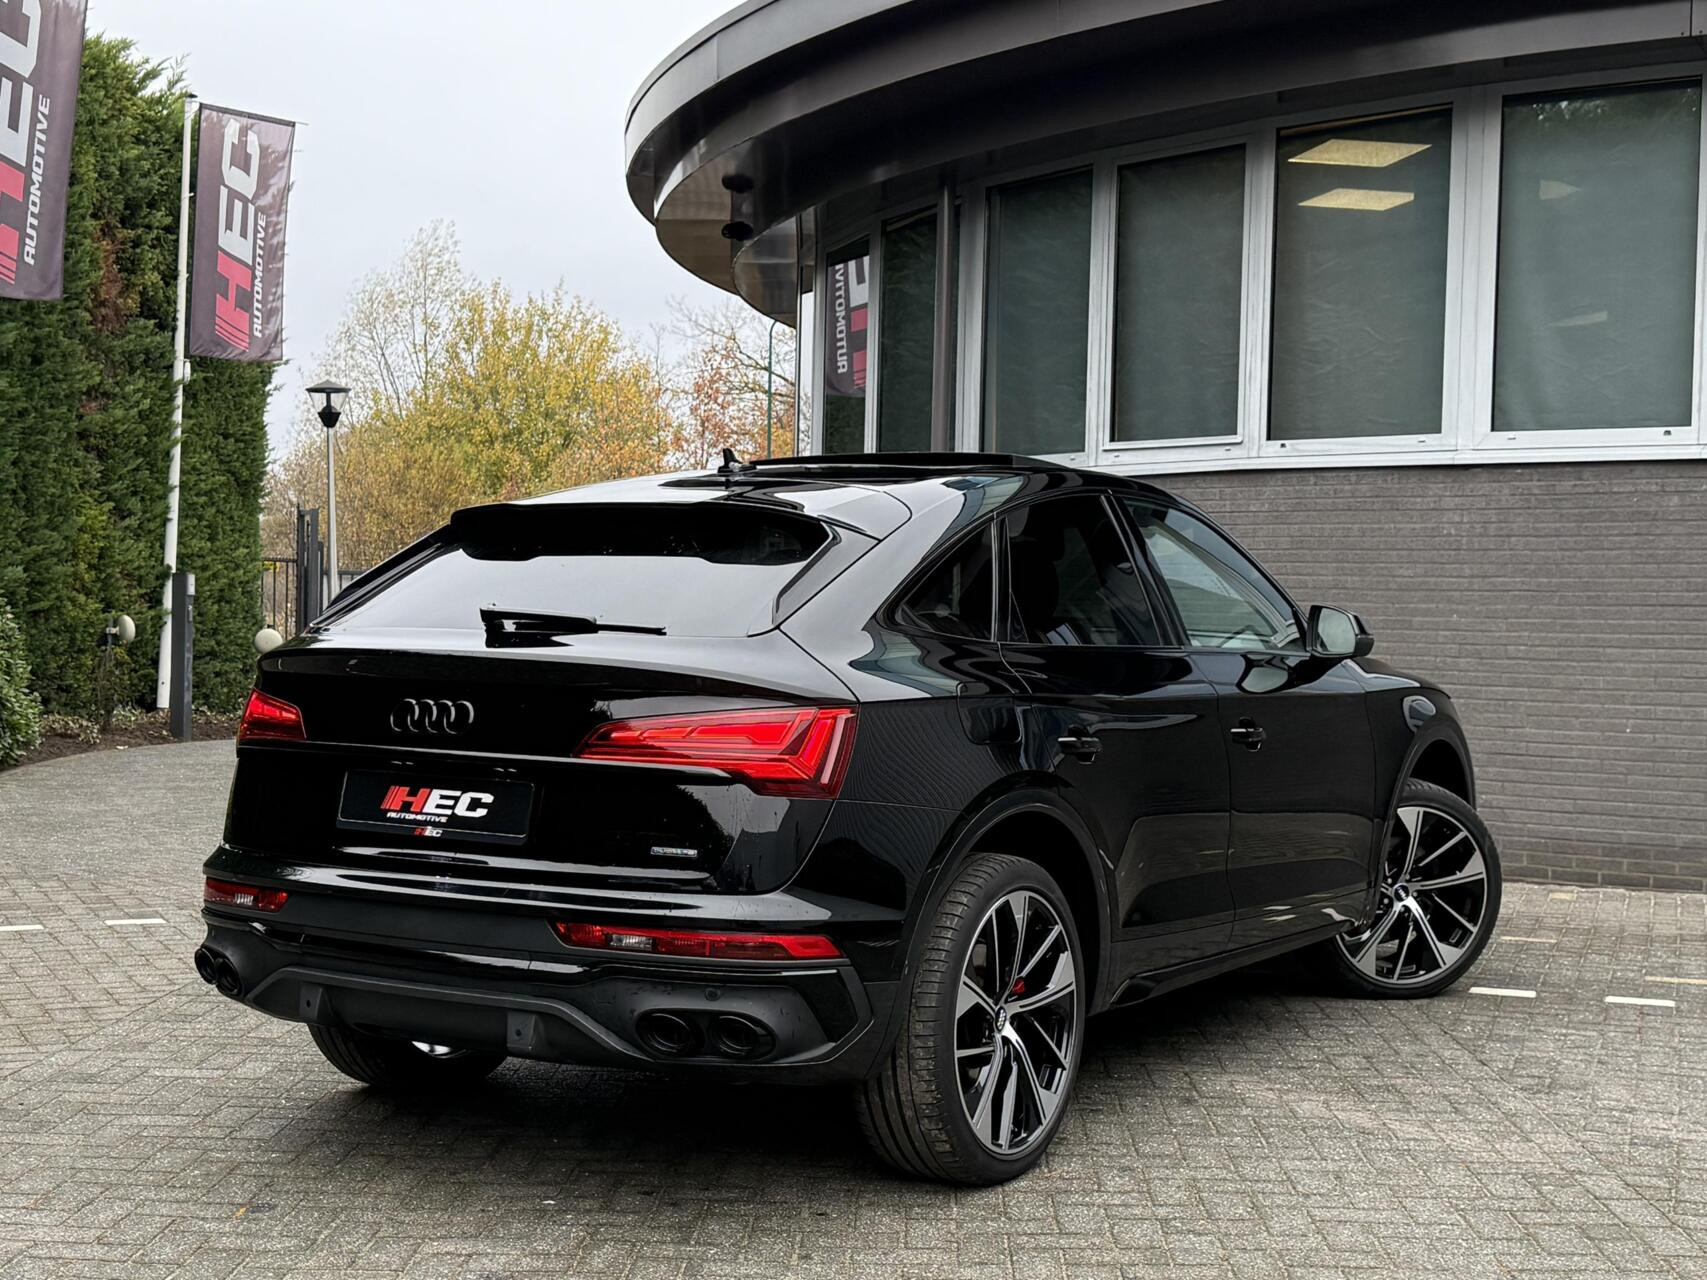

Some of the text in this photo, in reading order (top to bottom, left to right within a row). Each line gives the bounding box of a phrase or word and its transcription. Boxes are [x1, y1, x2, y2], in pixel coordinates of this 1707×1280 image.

[24, 94, 50, 266] AUTOMOTIVE
[215, 118, 260, 352] HEC
[253, 212, 267, 338] AUTOMOTIVE
[380, 785, 494, 818] HEC
[387, 812, 449, 823] AUTOMOTIVE
[414, 827, 443, 837] HEC
